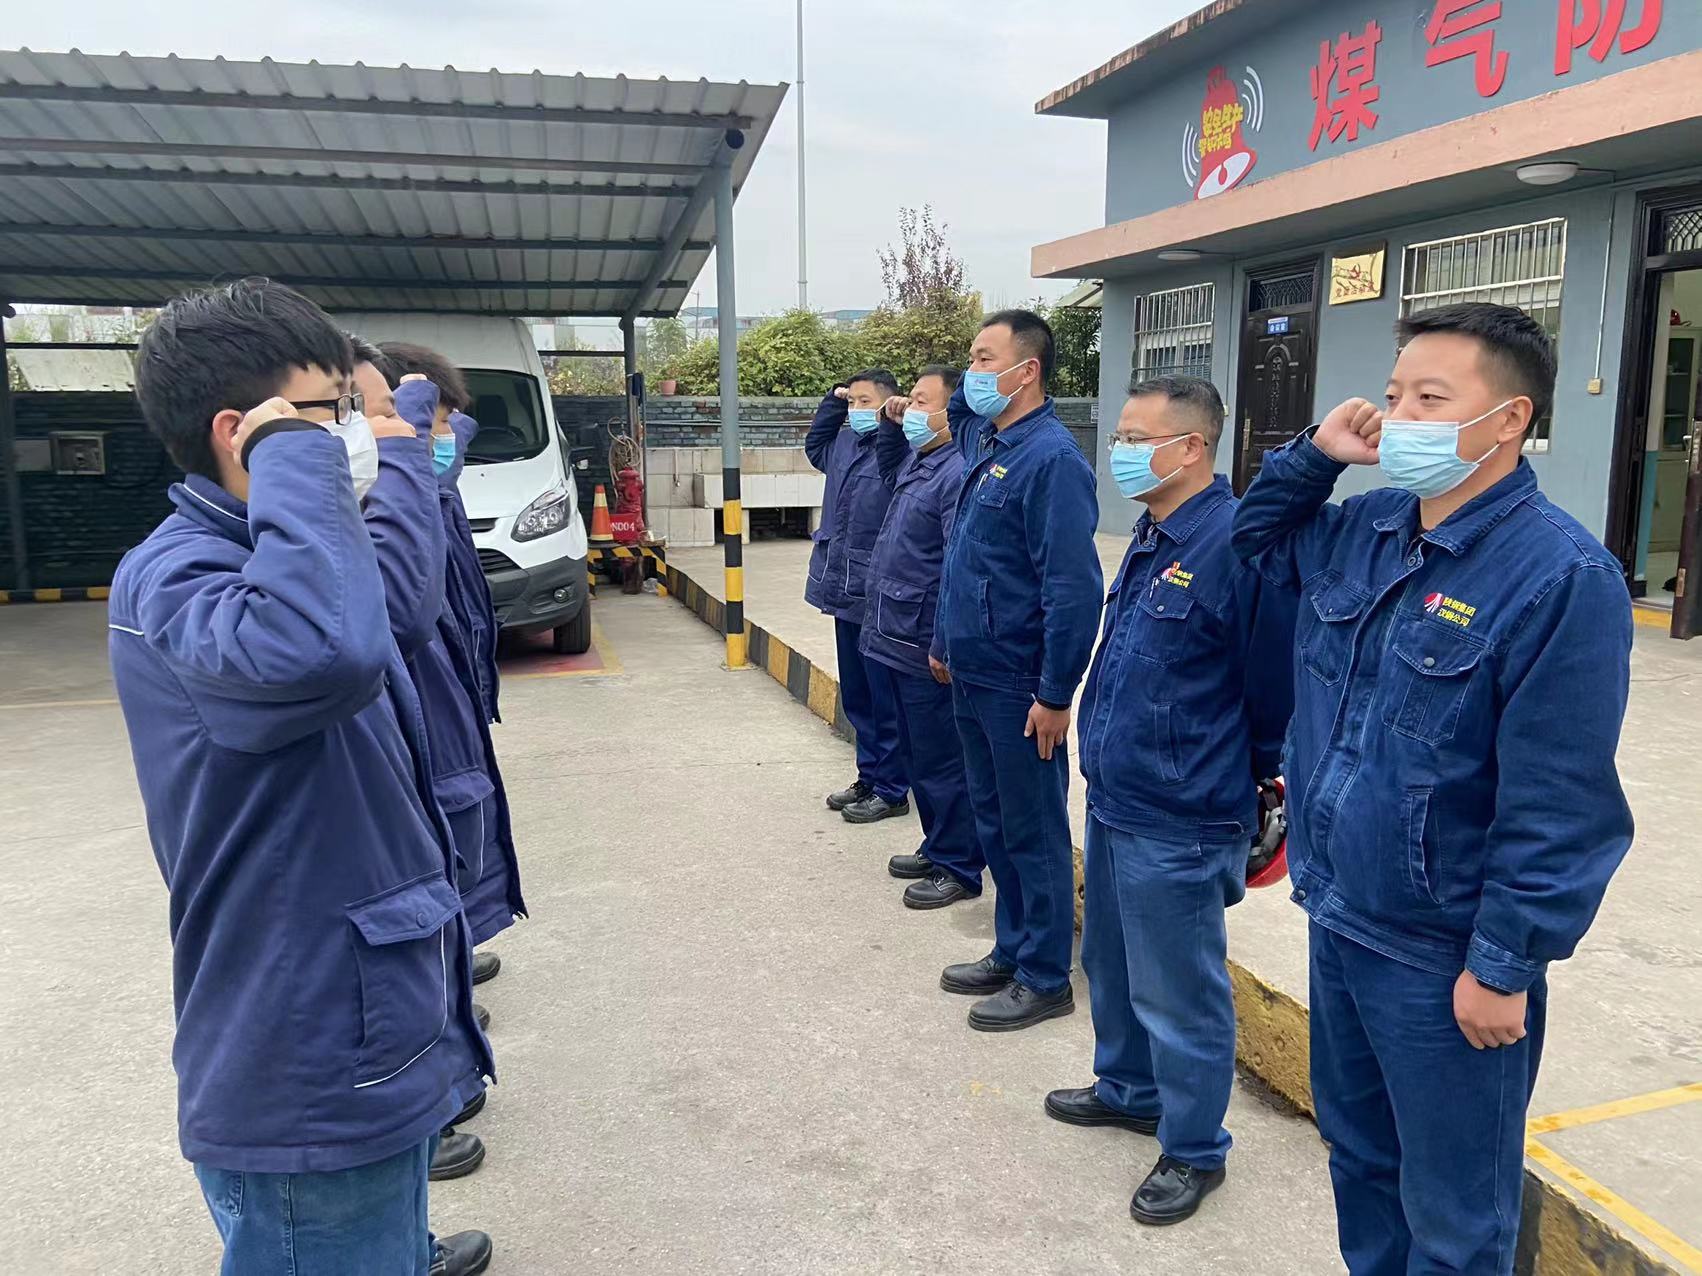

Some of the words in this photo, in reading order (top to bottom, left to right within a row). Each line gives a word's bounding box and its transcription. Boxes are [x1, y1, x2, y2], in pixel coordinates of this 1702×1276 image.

[1202, 103, 1244, 138] 安全生产
[1199, 128, 1232, 158] 警钟长鸣
